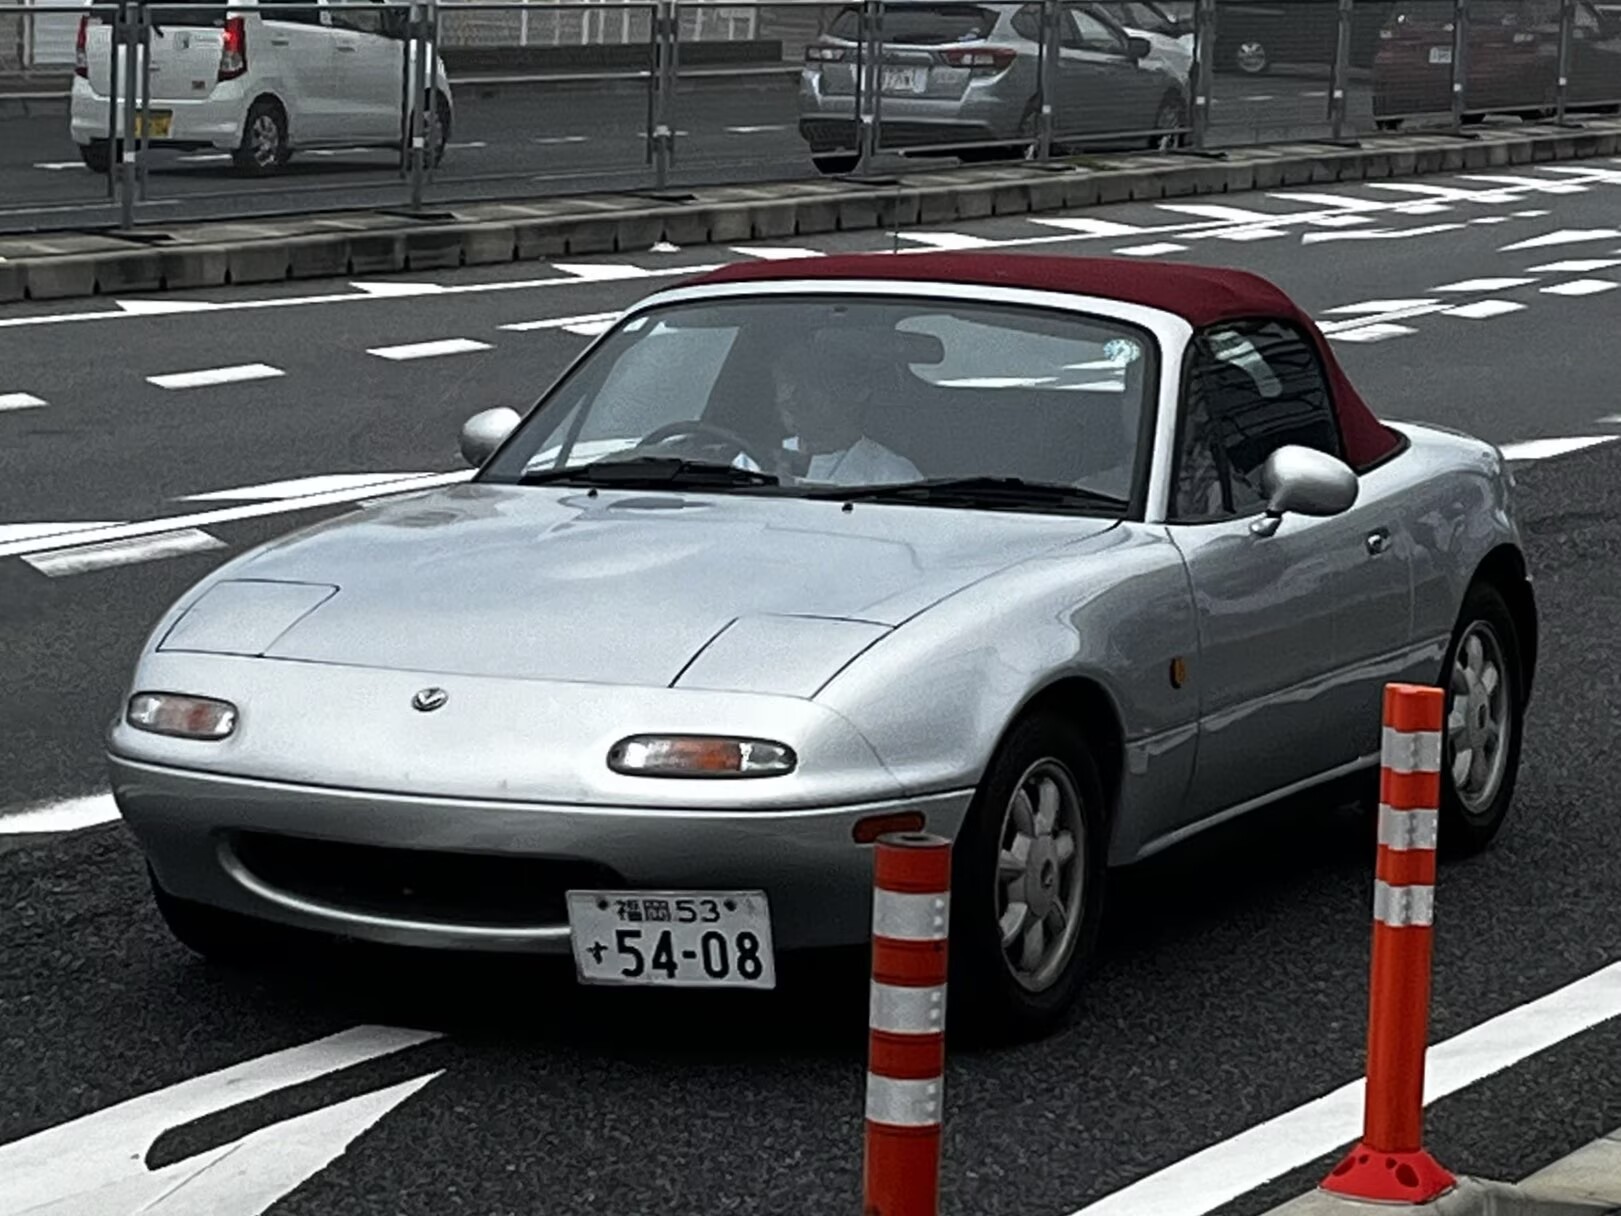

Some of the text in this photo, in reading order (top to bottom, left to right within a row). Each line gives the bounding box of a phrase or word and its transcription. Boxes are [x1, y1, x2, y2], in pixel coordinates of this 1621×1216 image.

[614, 899, 720, 923] 福岡 53
[615, 929, 763, 980] 54-08
